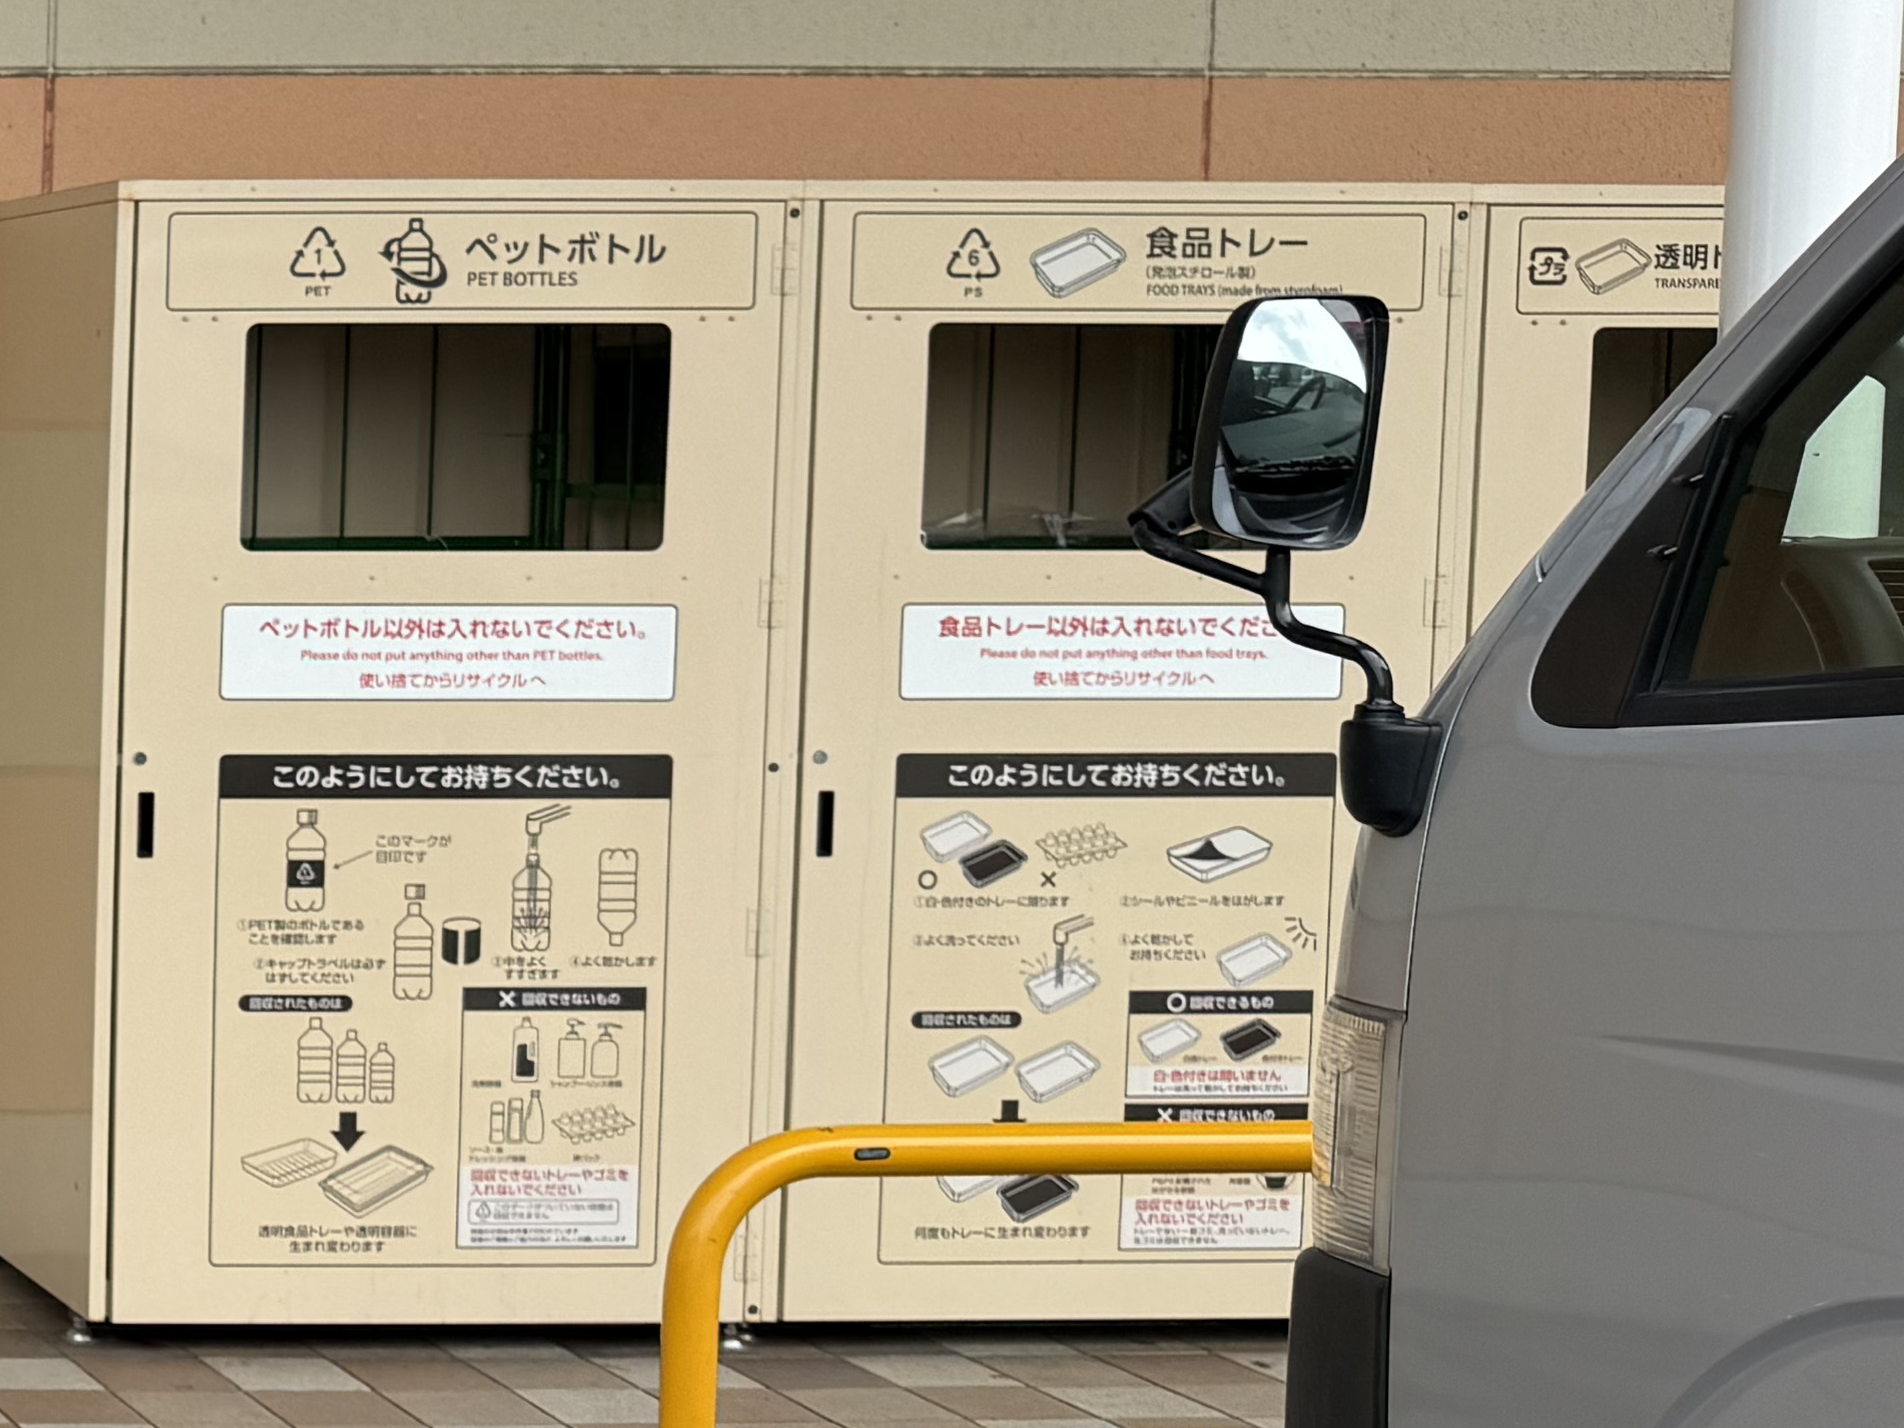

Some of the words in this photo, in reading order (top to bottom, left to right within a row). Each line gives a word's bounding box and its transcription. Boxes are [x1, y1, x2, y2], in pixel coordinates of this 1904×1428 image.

[465, 232, 667, 265] ペットボトル
[1146, 226, 1308, 259] 食品トレー
[467, 272, 500, 287] PET
[503, 272, 578, 287] BOTTLES
[305, 286, 332, 297] PET
[964, 287, 983, 298] PS
[1147, 284, 1179, 296] FOOD
[1181, 284, 1215, 296] TRAYS
[1218, 284, 1252, 297] (made
[259, 617, 645, 640] ペットボトル以外は入れないでください。
[301, 649, 339, 661] Please
[342, 648, 358, 661] do
[361, 649, 382, 661] not
[385, 650, 406, 664] put
[409, 649, 463, 664] anything
[466, 649, 499, 661] other
[502, 649, 529, 661] than
[533, 649, 555, 661] PET
[980, 647, 1017, 659] Please
[1020, 647, 1036, 659] do
[1039, 648, 1059, 659] not
[1062, 649, 1082, 661] put
[1085, 647, 1138, 661] anything
[1141, 647, 1172, 659] other
[1175, 647, 1202, 659] than
[1205, 647, 1234, 659] food
[360, 673, 546, 688] 使い捨てからリサイクルへ
[1033, 671, 1214, 687] 使い捨てからリサイクルへ
[272, 764, 620, 790] このようにしてお持ちください。
[948, 763, 1286, 789] このようにしてお持ちください。
